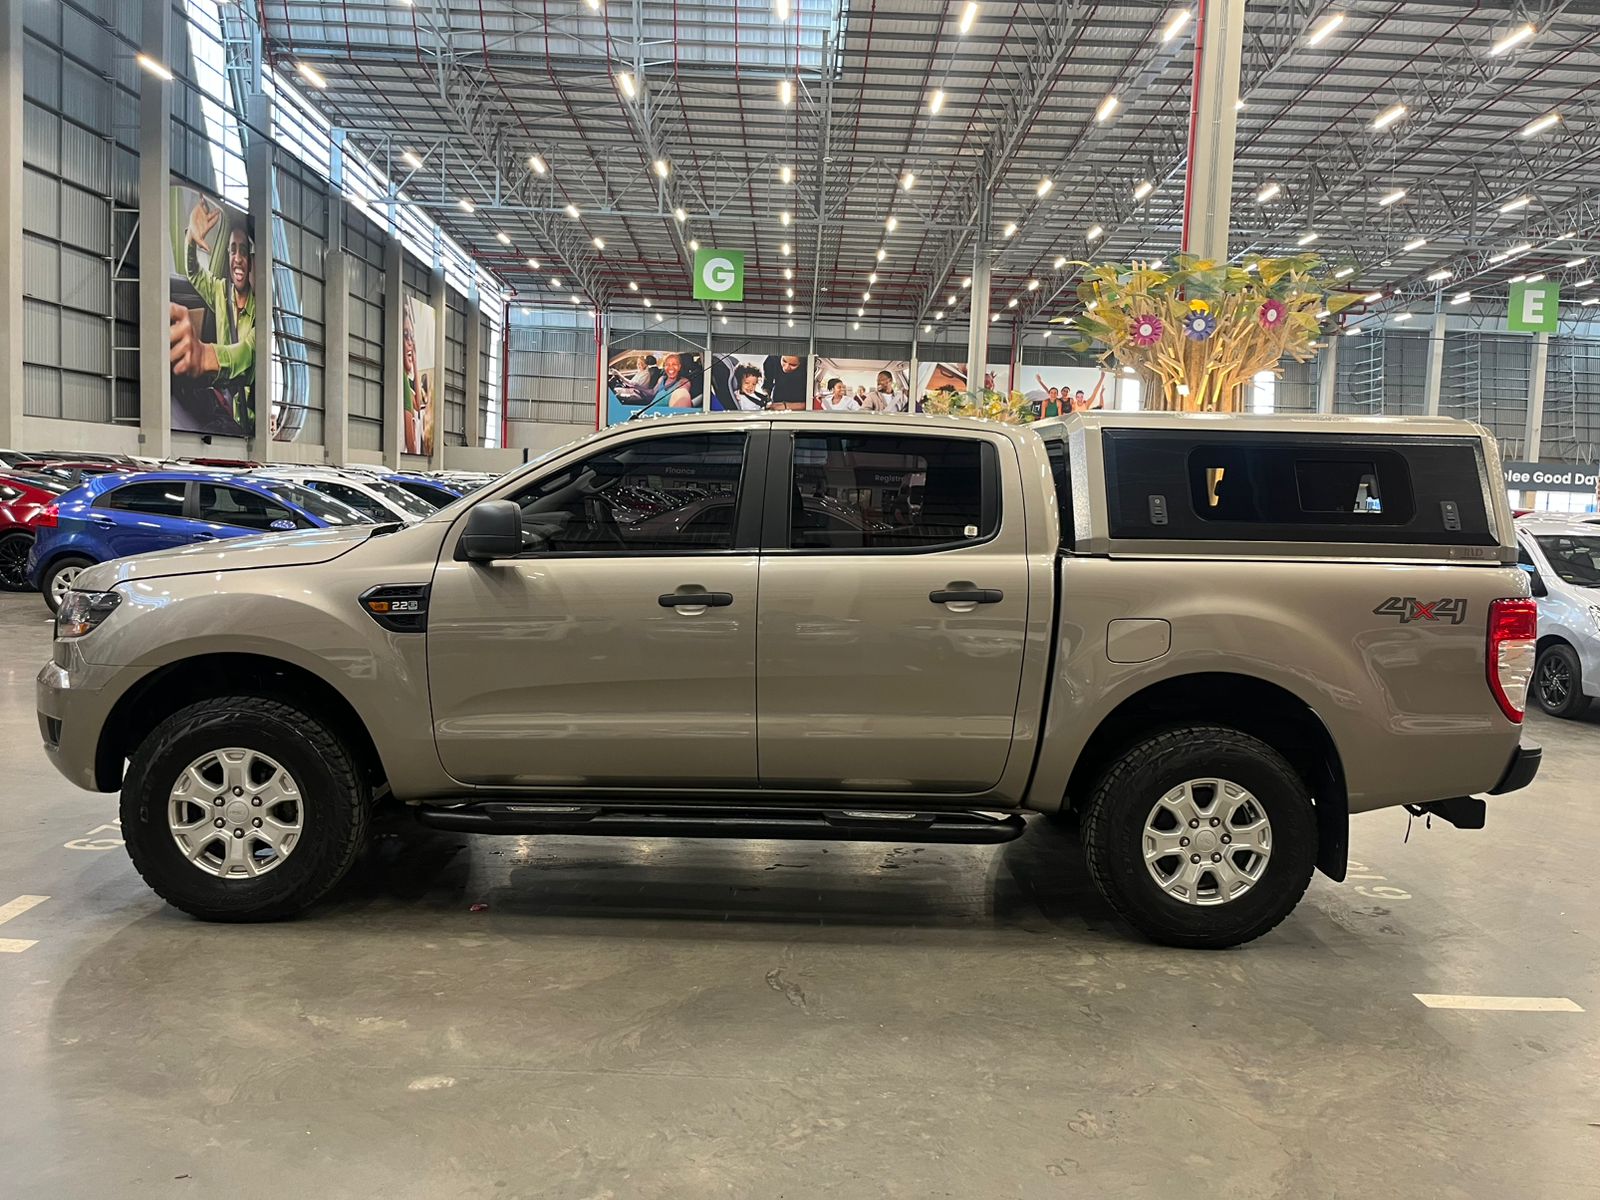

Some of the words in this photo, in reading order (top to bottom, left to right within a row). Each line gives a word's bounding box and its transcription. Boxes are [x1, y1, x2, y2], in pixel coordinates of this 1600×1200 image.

[703, 257, 735, 292] G
[1522, 289, 1546, 324] E
[665, 466, 696, 475] Finance
[1533, 471, 1571, 485] Good
